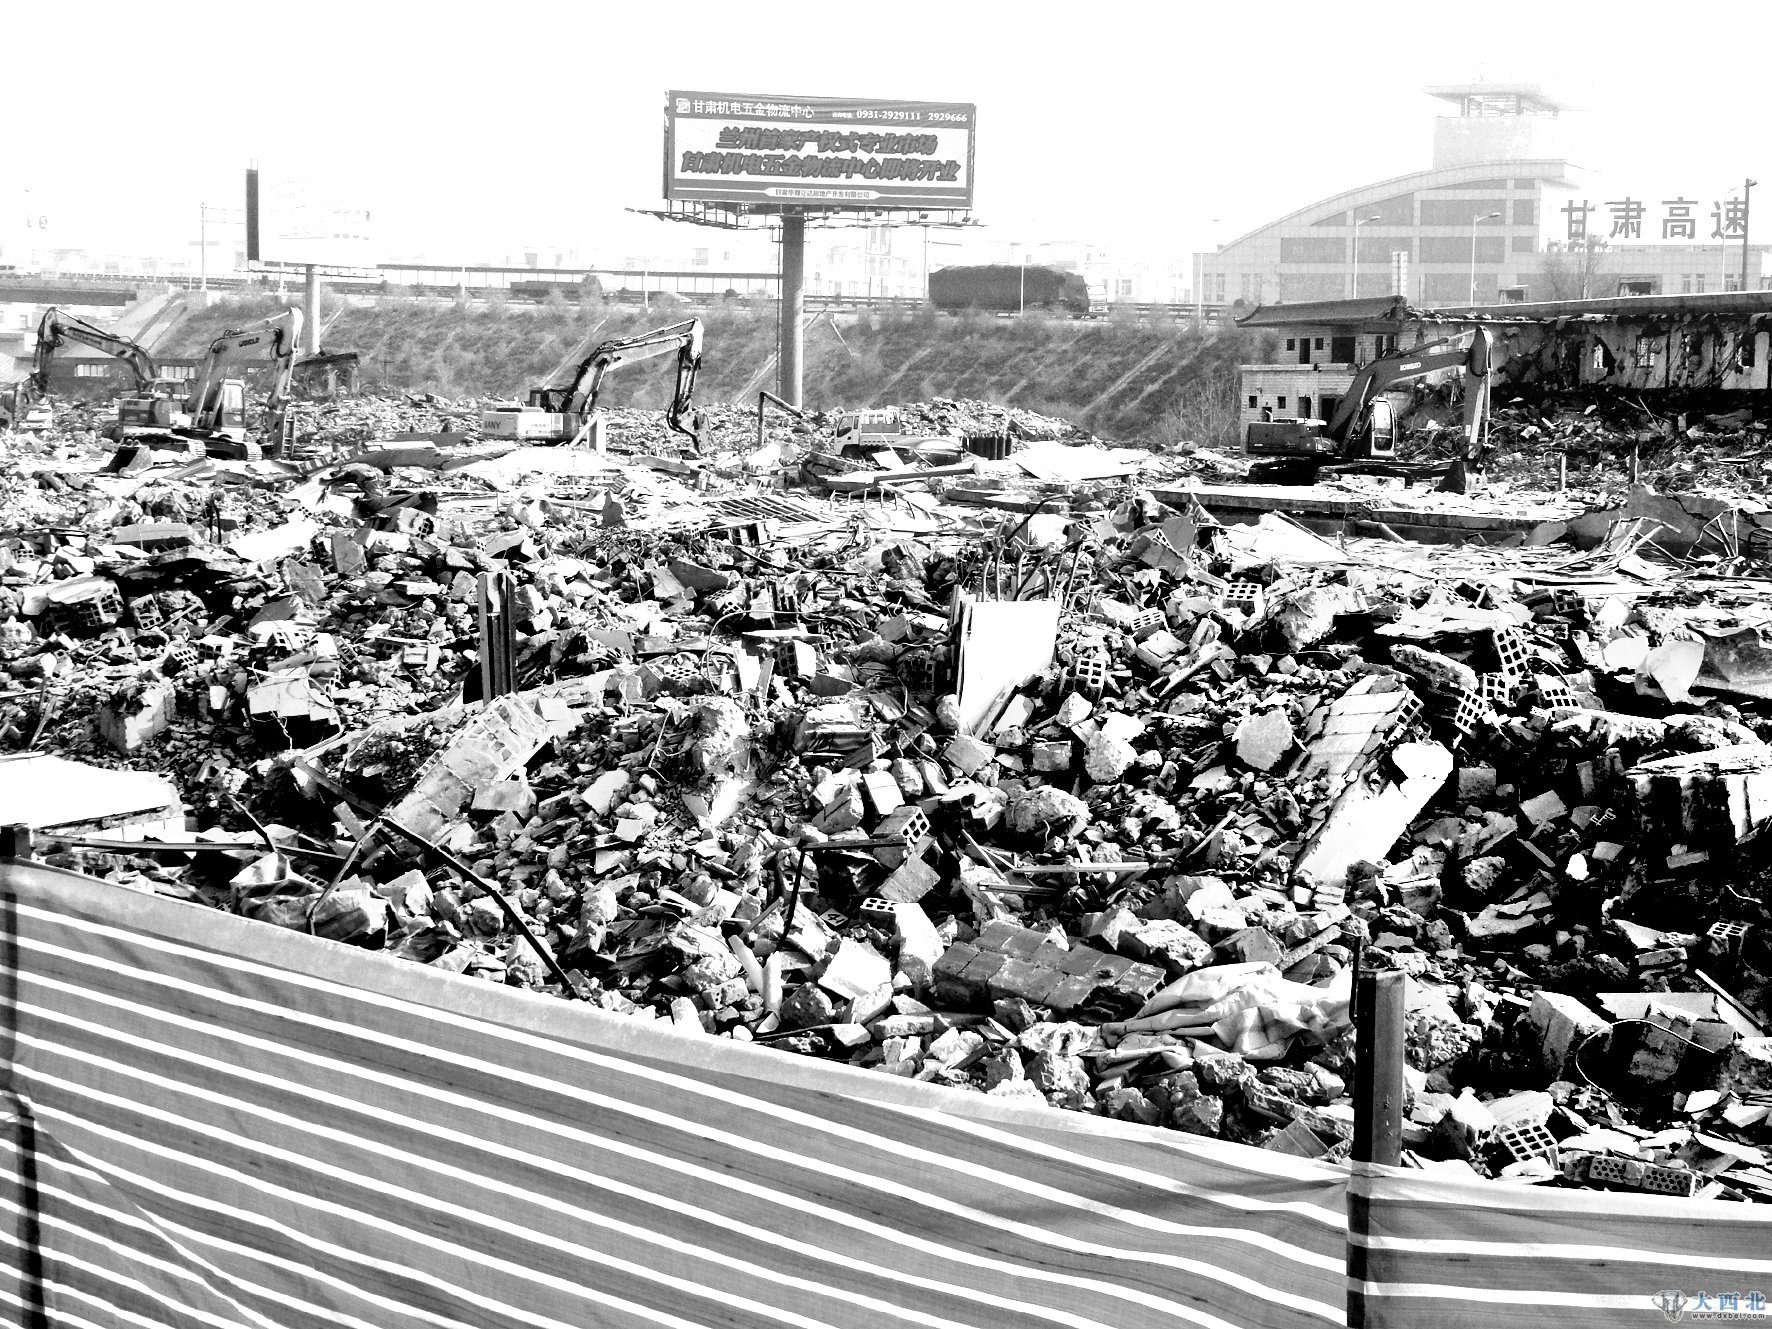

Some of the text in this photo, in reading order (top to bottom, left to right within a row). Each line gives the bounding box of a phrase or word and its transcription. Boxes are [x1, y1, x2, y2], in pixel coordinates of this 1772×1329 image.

[693, 100, 815, 118] 甘肃机电五金物流中心
[856, 110, 921, 120] 0931-2929111
[928, 112, 968, 122] 2929666
[716, 126, 938, 155] 兰州首家产权式专业市场
[681, 151, 962, 181] 甘肃机电五金物流中心即将开业
[1560, 196, 1748, 239] 甘肃高速
